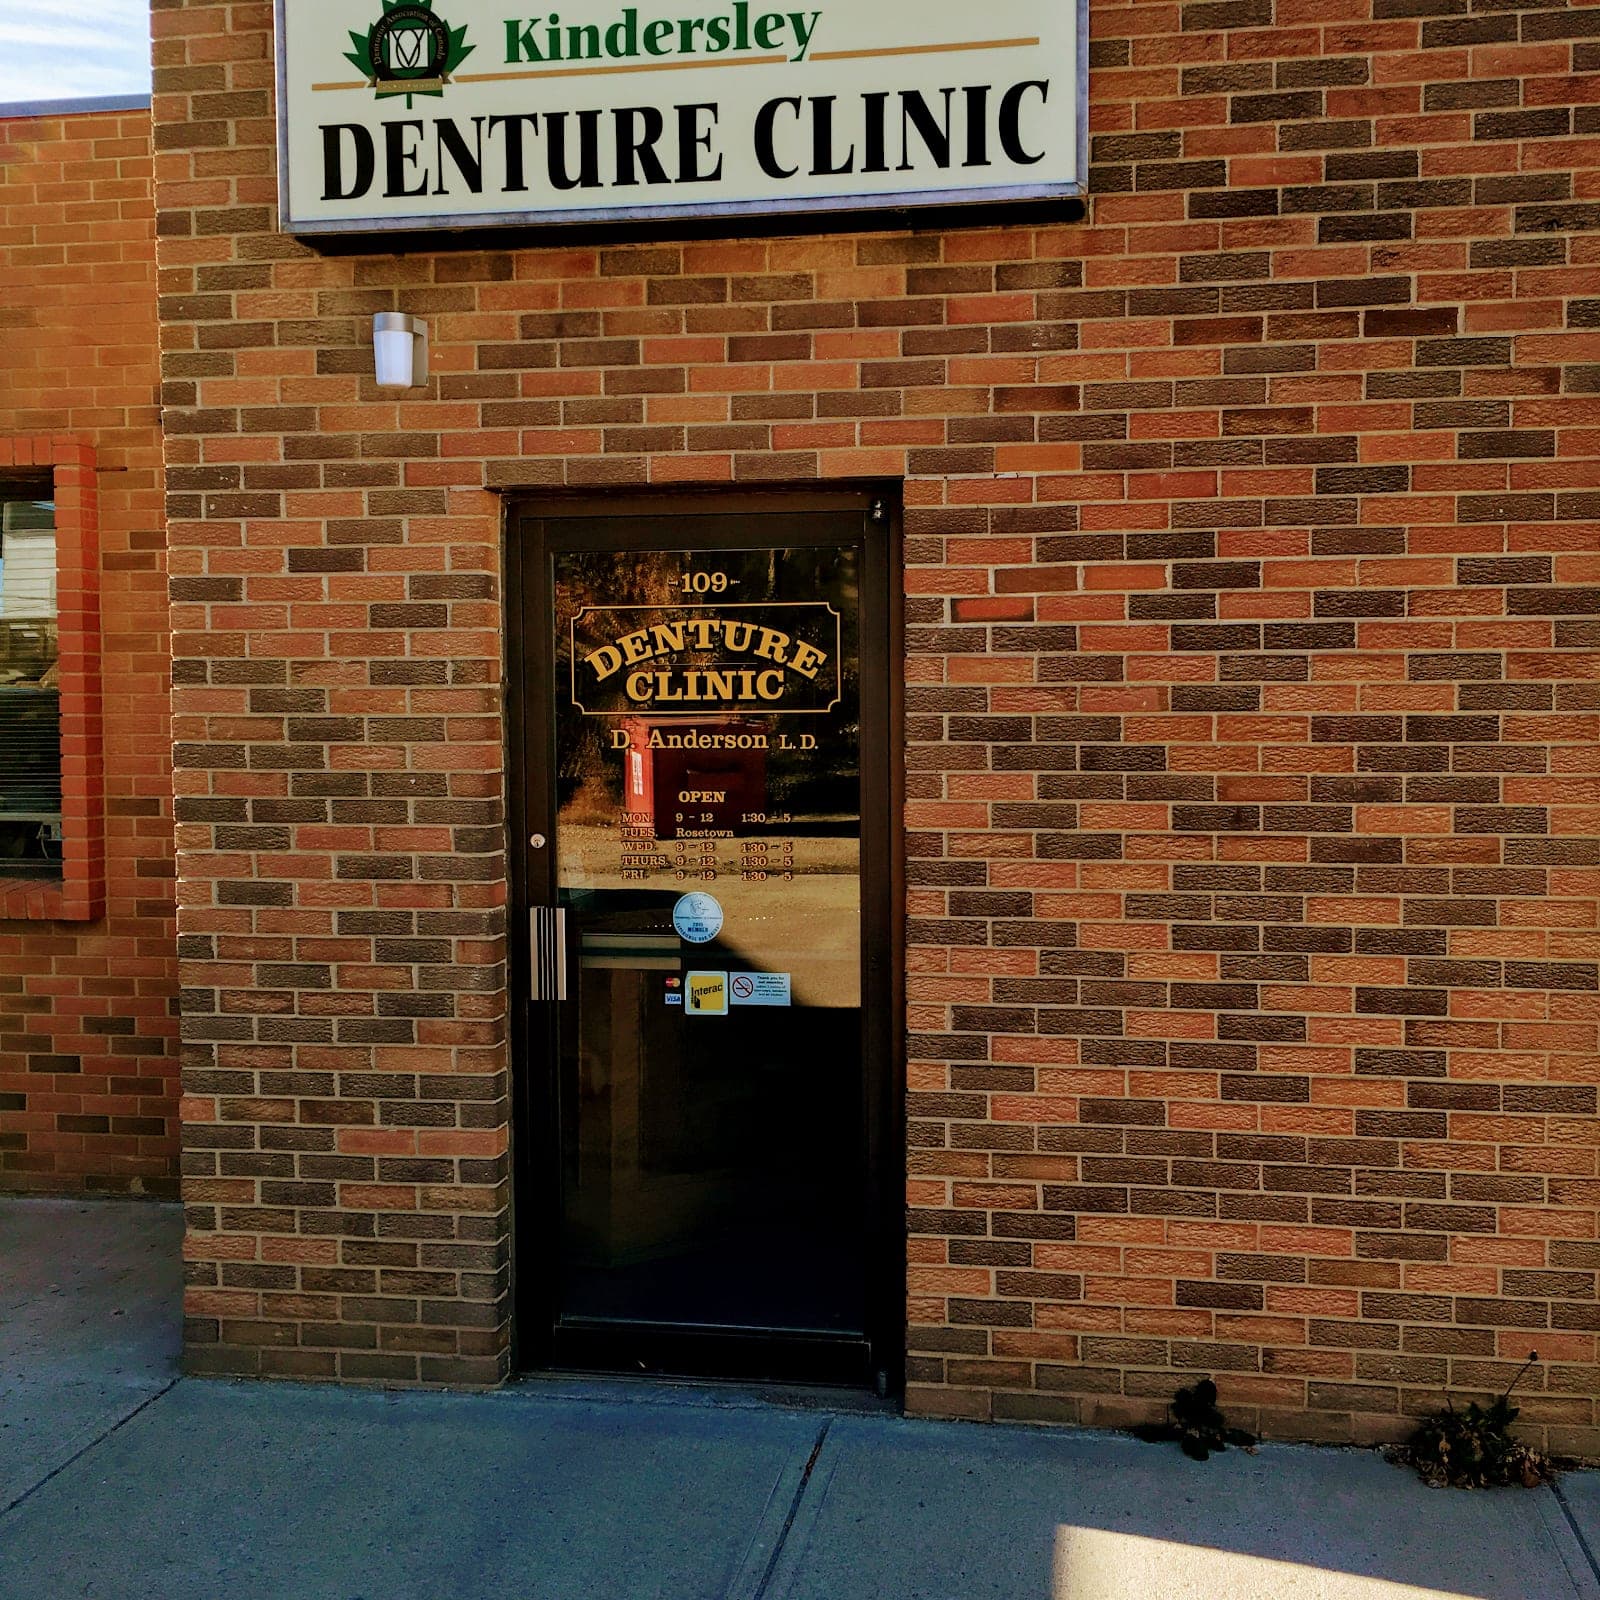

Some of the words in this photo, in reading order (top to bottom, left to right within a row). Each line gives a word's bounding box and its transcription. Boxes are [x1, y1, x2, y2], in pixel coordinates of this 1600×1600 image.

[503, 0, 823, 64] Kindersley
[318, 102, 723, 201] DENTURE
[753, 79, 1050, 180] CLINIC
[584, 619, 828, 682] DENTURE
[625, 670, 785, 701] CLINIC
[610, 729, 636, 750] D.
[646, 728, 769, 750] Anderson
[678, 791, 726, 803] OPEN
[621, 813, 654, 823] MON.
[675, 813, 684, 823] 9
[700, 813, 714, 823] 12
[741, 813, 766, 823] 1:30
[783, 813, 791, 823] 5
[621, 827, 658, 838] TUES.
[676, 827, 734, 838] Rosetown
[621, 841, 657, 851] WED.
[675, 842, 684, 852] 9
[700, 842, 714, 852] 12
[741, 843, 767, 853] 1:30
[783, 842, 792, 852] 5
[621, 855, 669, 866] THURS.
[675, 856, 685, 866] 9
[700, 856, 715, 866] 12
[741, 856, 767, 866] 1:30
[783, 856, 792, 866] 5
[621, 869, 650, 880] FRI.
[675, 870, 685, 880] 9
[700, 870, 715, 880] 12
[741, 871, 767, 881] 1:30
[783, 871, 792, 881] 5
[691, 984, 723, 997] Interac
